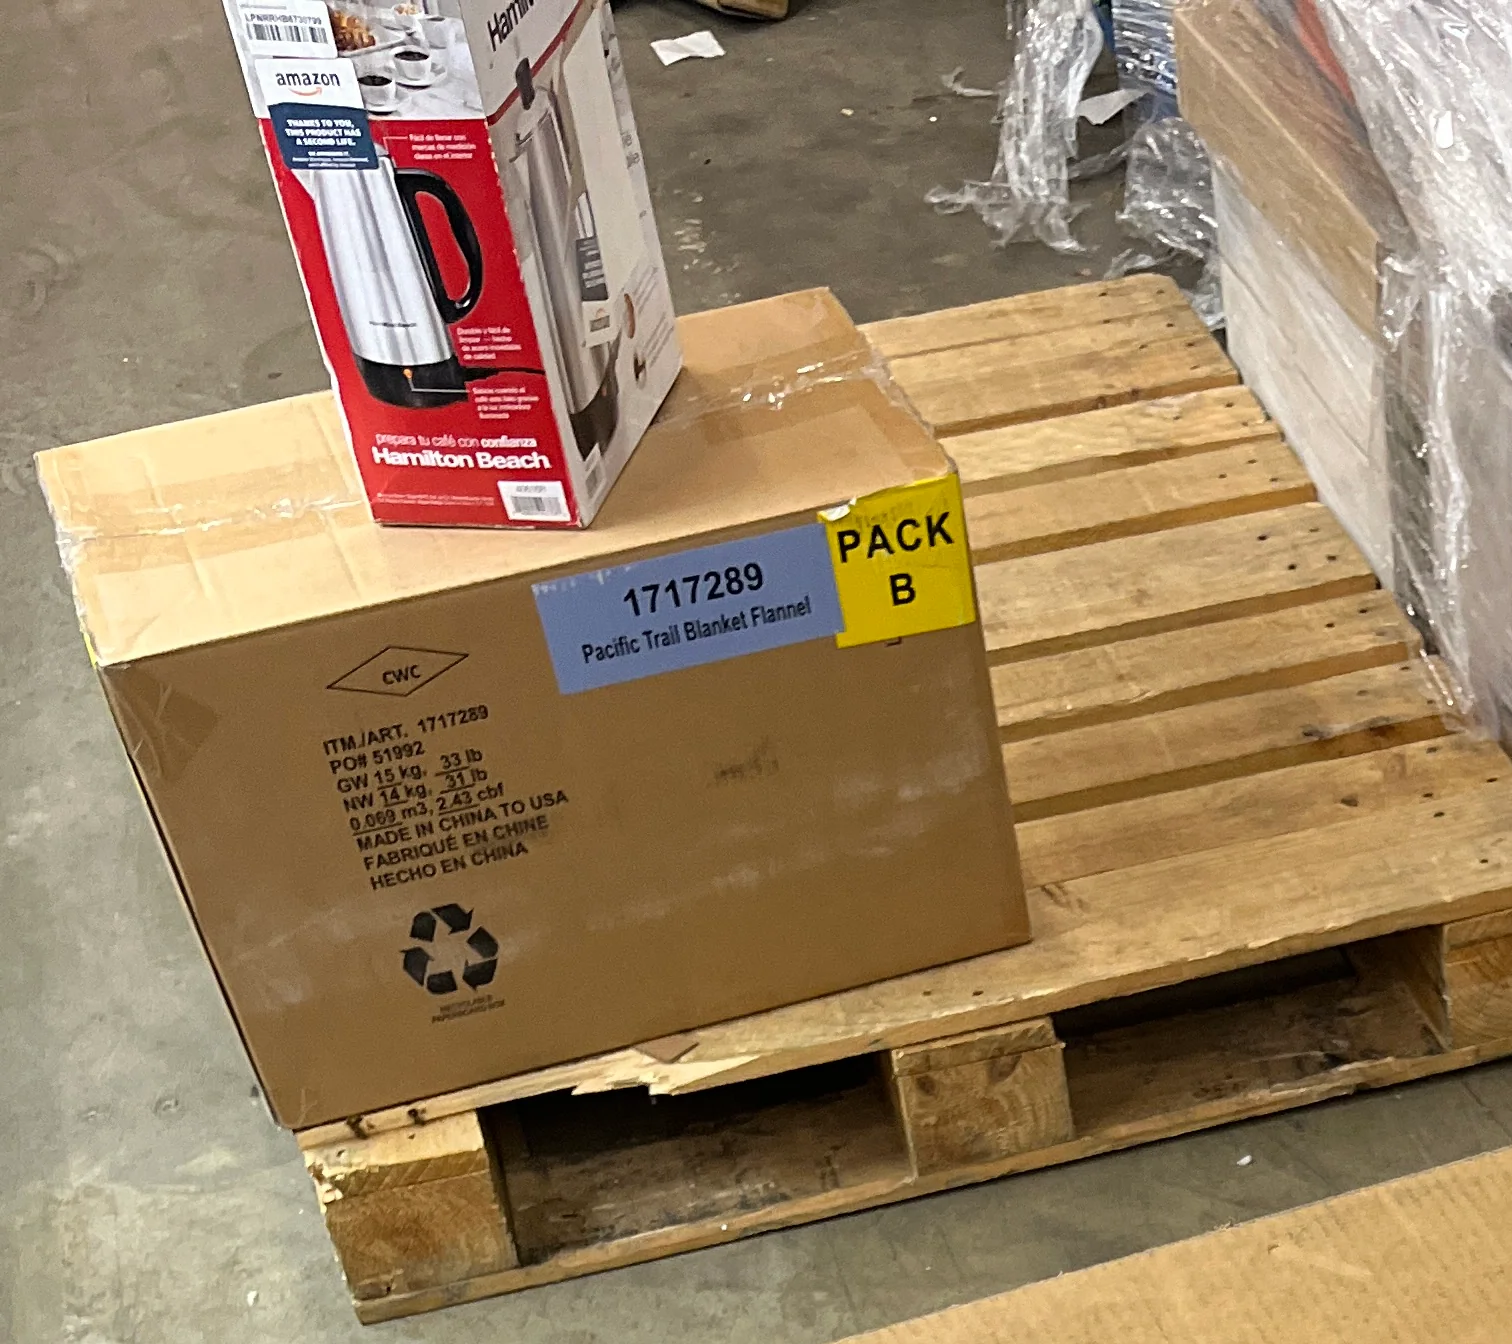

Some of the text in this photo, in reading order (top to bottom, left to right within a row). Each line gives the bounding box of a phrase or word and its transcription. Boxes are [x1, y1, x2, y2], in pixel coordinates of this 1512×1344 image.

[276, 72, 341, 87] amazon
[371, 446, 552, 470] Hamilton Beach
[418, 434, 430, 446] tu
[432, 434, 456, 448] café
[457, 438, 480, 448] con
[480, 434, 537, 449] confianza
[836, 511, 954, 563] PACK
[623, 562, 765, 617] 1717289
[888, 572, 917, 606] B
[581, 596, 812, 665] Pacific Trail Blanket Flannel
[381, 664, 422, 686] CWC
[322, 704, 489, 757] ITM./ART. 1717289
[329, 740, 425, 775] PO# 51992
[336, 773, 369, 794] GW
[374, 767, 396, 786] 15
[438, 752, 463, 773] 33
[465, 748, 483, 764] lb
[343, 793, 374, 813] NW
[380, 786, 401, 804] 14
[444, 774, 465, 790] 31
[471, 769, 488, 785] lb
[401, 800, 434, 821] m3,
[436, 790, 474, 813] 2.43
[477, 782, 505, 803] cbf
[356, 789, 570, 852] MADE IN CHINA TO USA
[363, 815, 550, 871] FABRIQUÉ EN CHINE
[369, 841, 529, 890] HECHO EN CHINA
